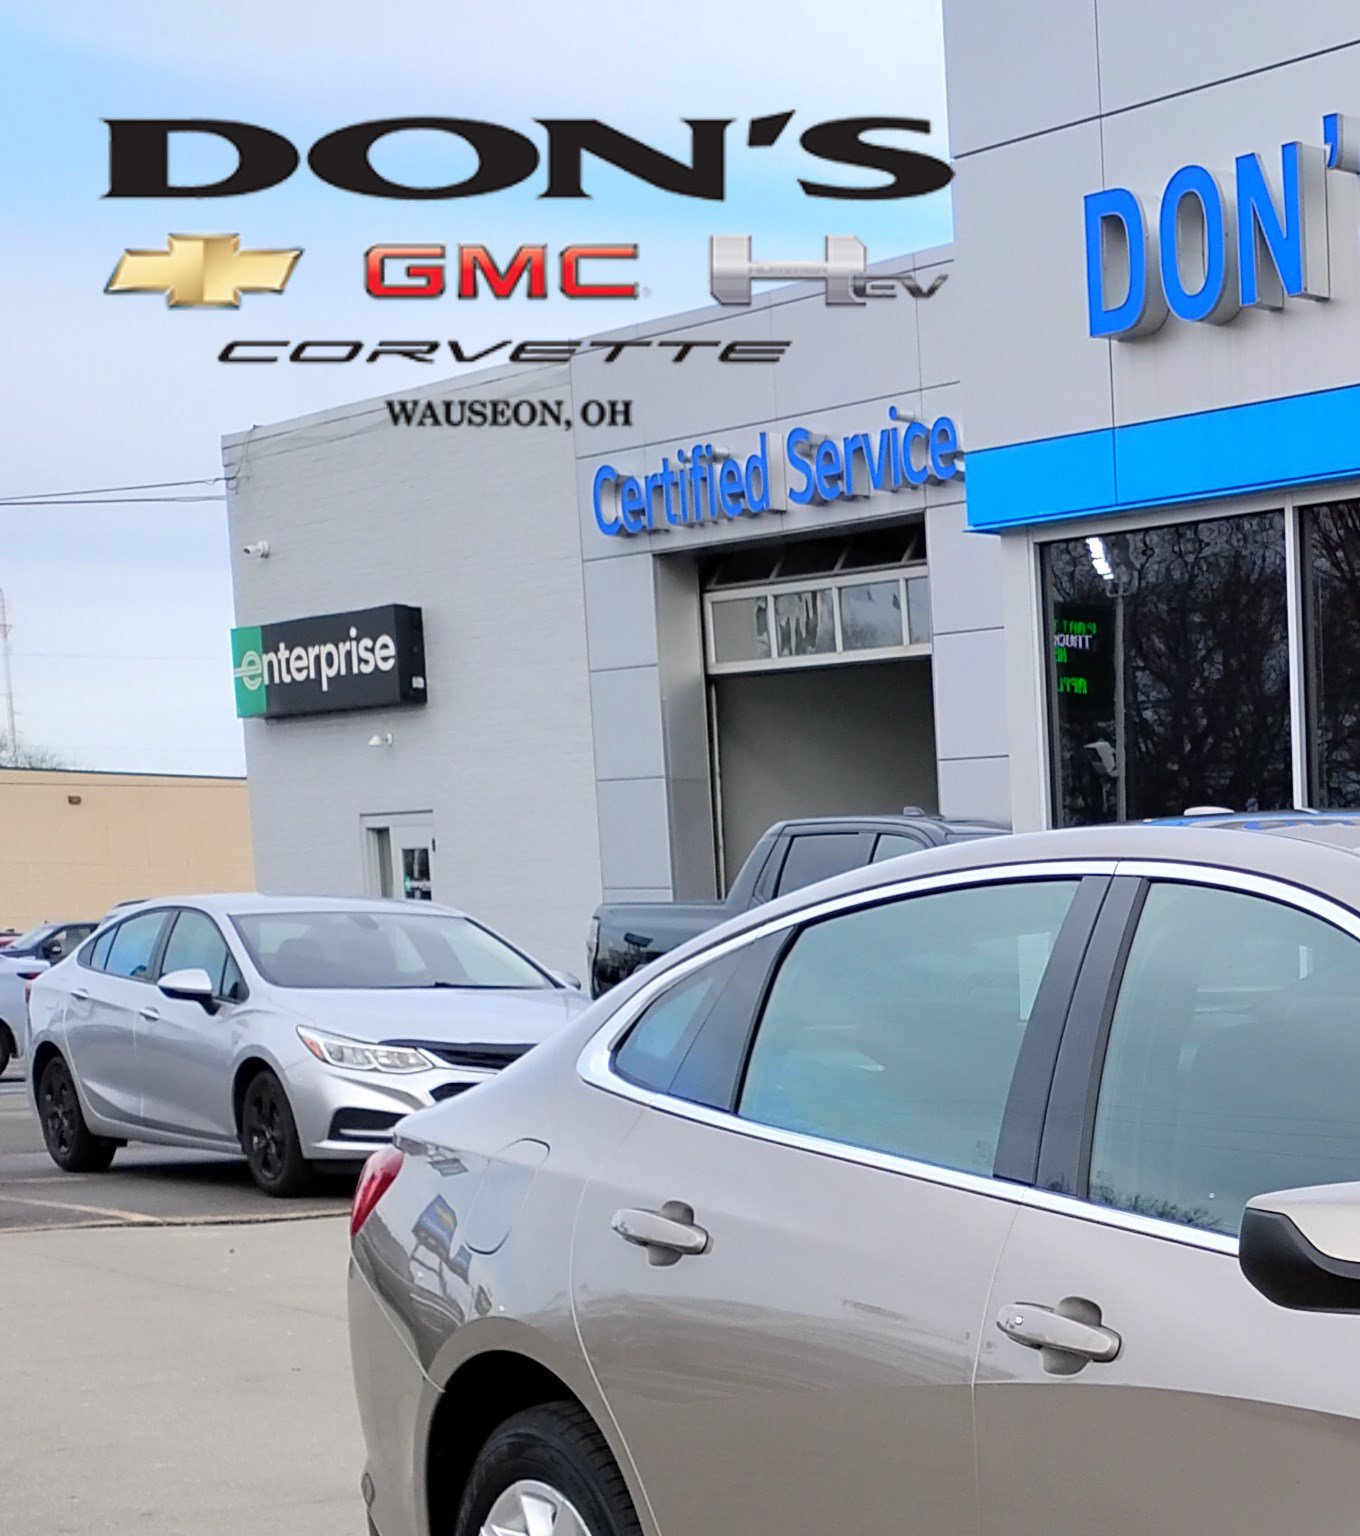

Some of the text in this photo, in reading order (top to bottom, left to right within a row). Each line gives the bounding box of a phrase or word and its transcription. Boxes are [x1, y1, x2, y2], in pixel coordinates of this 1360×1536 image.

[593, 405, 960, 537] Certified Service
[236, 626, 397, 691] enterprise
